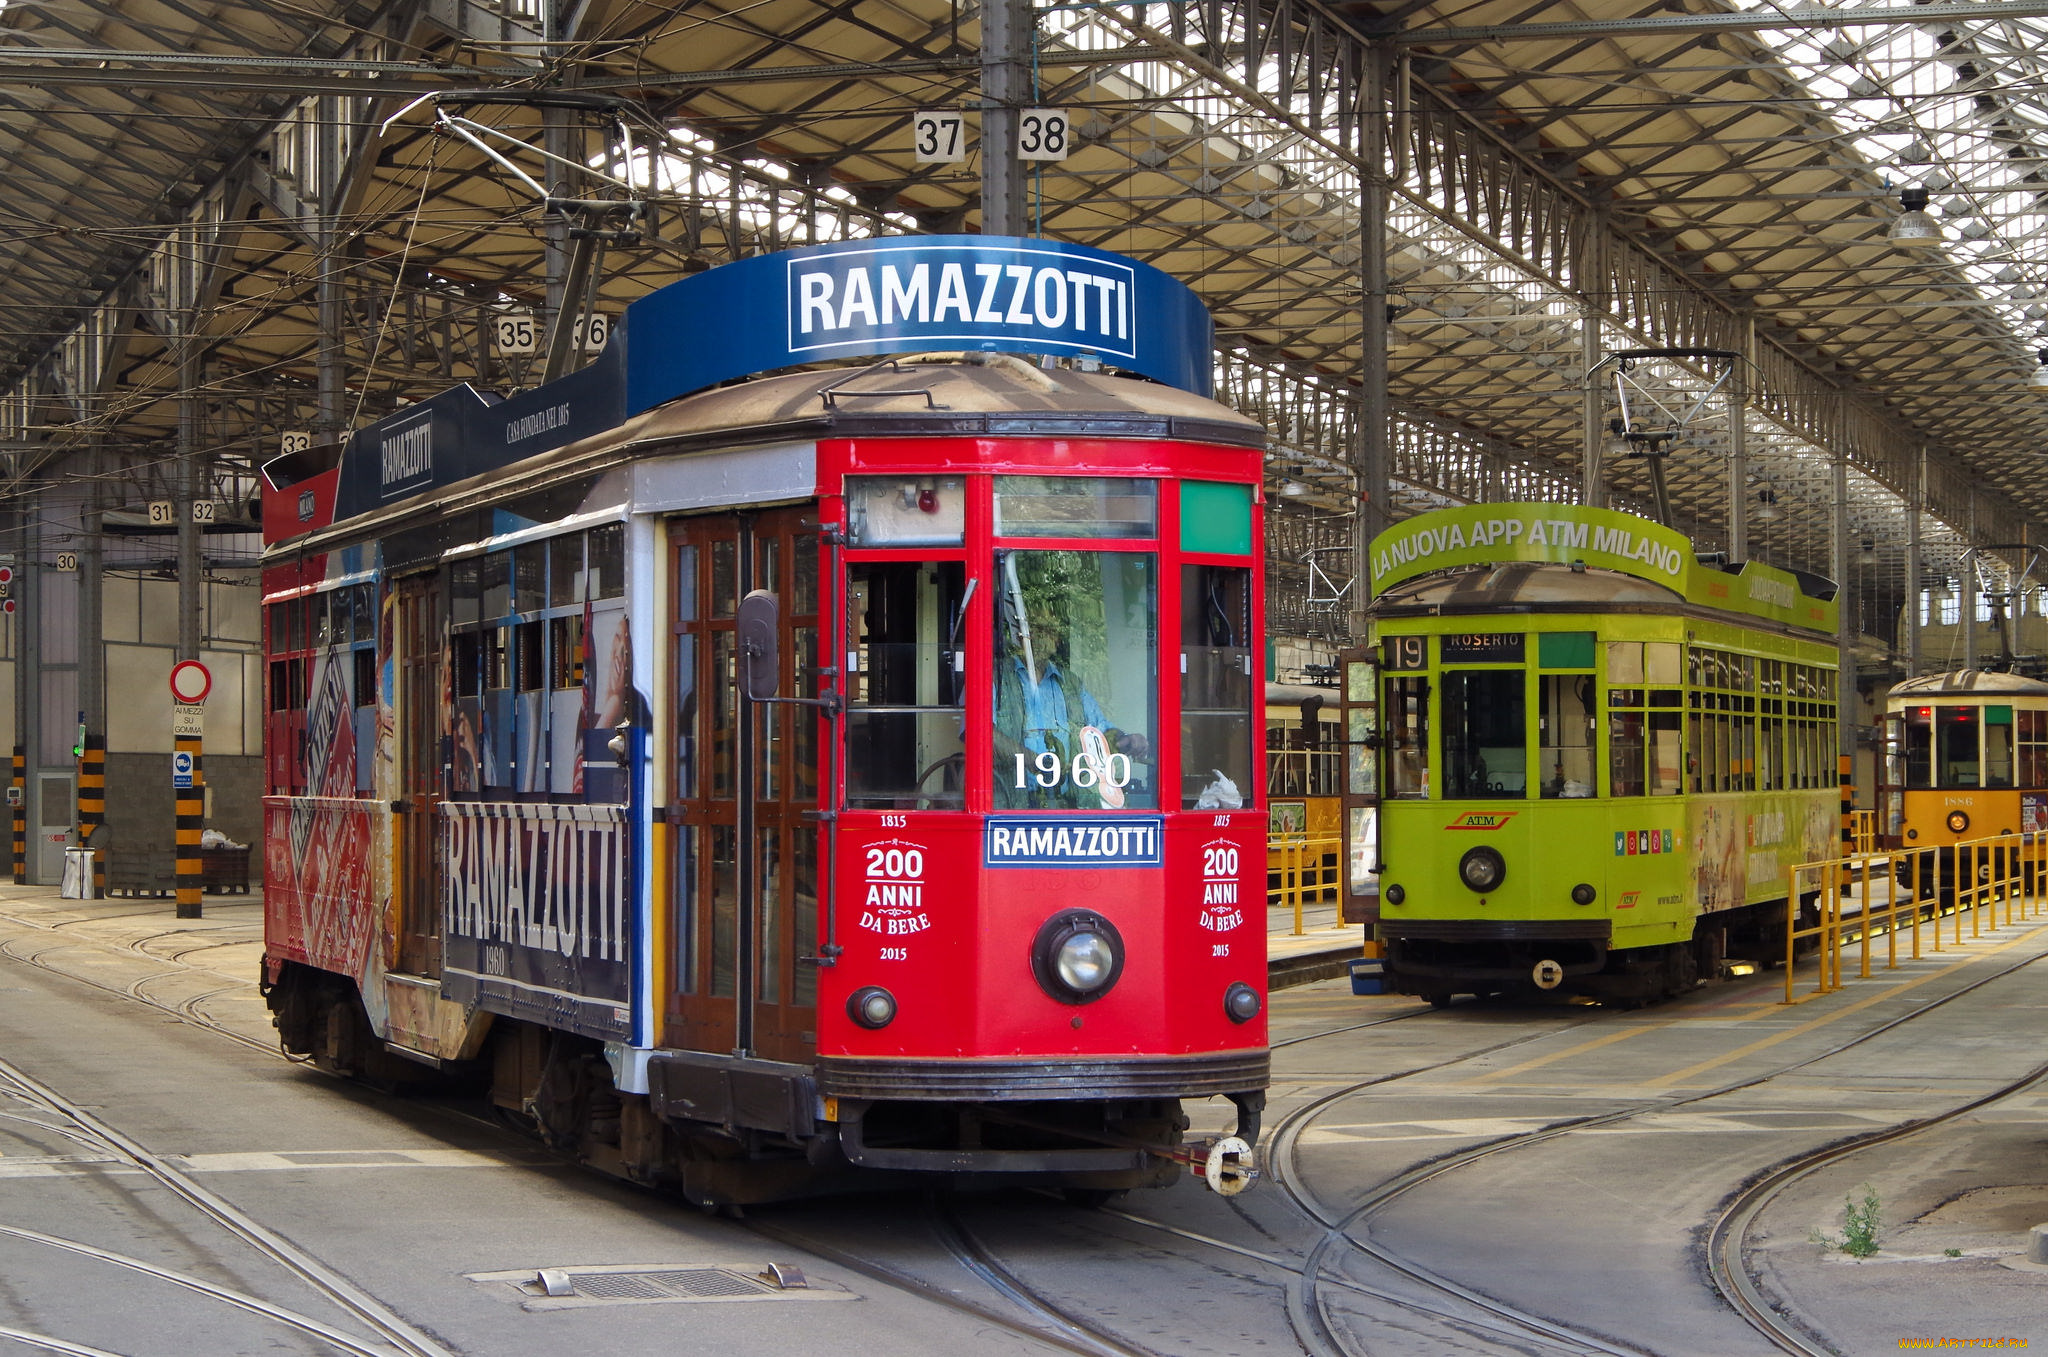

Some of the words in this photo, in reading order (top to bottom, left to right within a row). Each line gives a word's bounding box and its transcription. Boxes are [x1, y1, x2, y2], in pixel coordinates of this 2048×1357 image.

[917, 118, 960, 156] 37
[1021, 116, 1065, 153] 38
[800, 263, 1127, 340] RAMAZZOTTI
[500, 321, 533, 348] 35
[506, 420, 520, 444] CASA
[521, 411, 545, 440] FONDATA
[545, 405, 558, 431] NEL
[381, 422, 432, 486] RAMAZZOTTI
[152, 505, 169, 521] 31
[194, 503, 213, 520] 32
[1373, 551, 1392, 581] LA
[1391, 524, 1466, 565] NUOVA
[1470, 518, 1523, 547] APP
[1527, 519, 1589, 549] ATM
[1593, 526, 1682, 576] MILANO
[58, 555, 76, 568] 30
[1451, 633, 1519, 647] ROSERIO
[1395, 637, 1423, 669] 19
[183, 707, 204, 715] MEZZI
[184, 716, 194, 724] SU
[174, 726, 202, 734] GOMMA
[1014, 752, 1131, 788] 1960
[1944, 797, 1974, 806] 1886
[881, 815, 907, 828] 1815
[1213, 815, 1230, 827] 1815
[1466, 816, 1495, 826] ATM
[993, 826, 1154, 856] RAMAZZOTTI
[866, 849, 923, 878] 200
[1203, 848, 1238, 876] 200
[446, 803, 623, 962] RAMAZZOTTI
[866, 885, 921, 907] ANNI
[1203, 884, 1237, 905] ANNI
[859, 911, 882, 933] DA
[887, 913, 931, 935] BERE
[1200, 911, 1214, 931] DA
[1216, 909, 1244, 932] BERE
[485, 945, 505, 976] 1960
[880, 947, 907, 960] 2015
[1212, 944, 1229, 957] 2015
